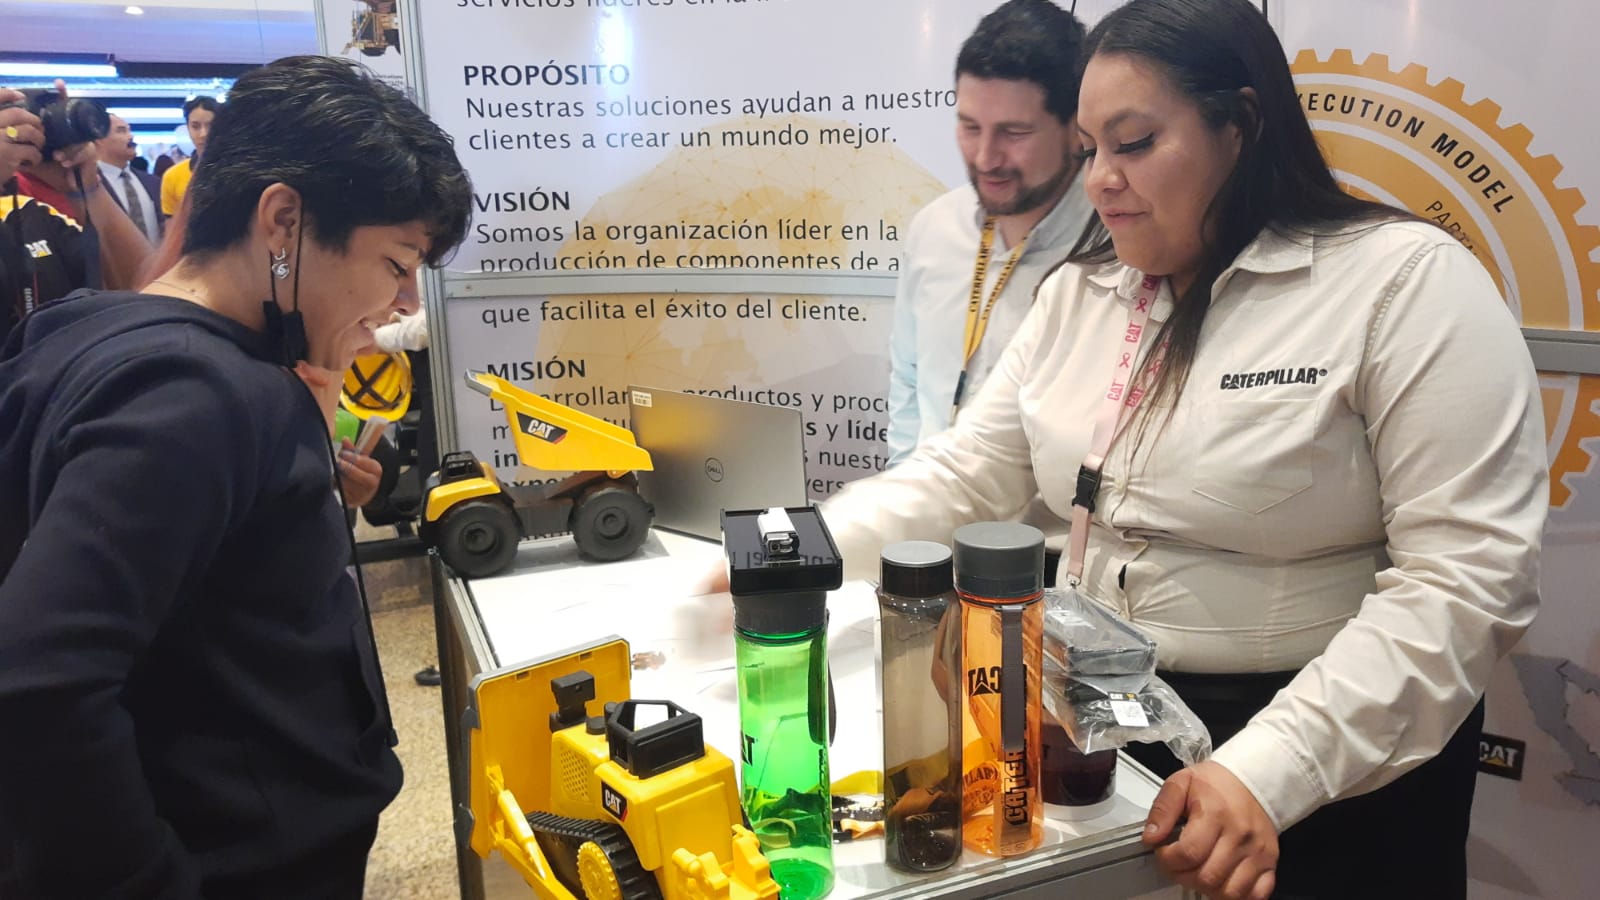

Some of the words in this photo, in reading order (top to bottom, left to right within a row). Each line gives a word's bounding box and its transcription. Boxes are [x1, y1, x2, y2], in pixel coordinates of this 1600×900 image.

[463, 60, 630, 86] PROPÓSITO
[466, 98, 585, 119] Nuestras
[596, 95, 732, 117] soluciones
[742, 90, 831, 119] ayudan
[842, 94, 855, 111] a
[865, 88, 957, 111] nuestro
[469, 129, 571, 150] clientes
[582, 133, 596, 149] a
[606, 131, 670, 148] crear
[681, 131, 711, 148] un
[722, 124, 809, 147] mundo
[820, 123, 898, 149] mejor.
[1298, 92, 1425, 138] ECUTION
[1430, 132, 1515, 214] MODEL
[473, 186, 570, 213] VISIÓN
[477, 223, 564, 244] Somos
[575, 220, 596, 241] la
[606, 219, 768, 245] organización
[778, 218, 832, 241] líder
[841, 224, 869, 241] en
[879, 219, 898, 242] la
[480, 250, 626, 273] producción
[637, 249, 666, 269] de
[676, 252, 841, 270] componentes
[850, 250, 879, 272] de
[482, 307, 530, 328] que
[540, 300, 625, 321] facilita
[635, 299, 655, 318] el
[665, 298, 727, 319] éxito
[736, 298, 772, 318] del
[781, 298, 867, 322] cliente.
[1124, 320, 1143, 344] CAT
[487, 355, 586, 381] MISIÓN
[811, 393, 824, 412] y
[833, 392, 889, 413] proc
[1107, 379, 1125, 401] CAT
[527, 419, 554, 439] CAT
[826, 423, 839, 442] y
[848, 419, 888, 442] líde
[1479, 741, 1519, 768] CAT
[604, 788, 621, 816] CAT
